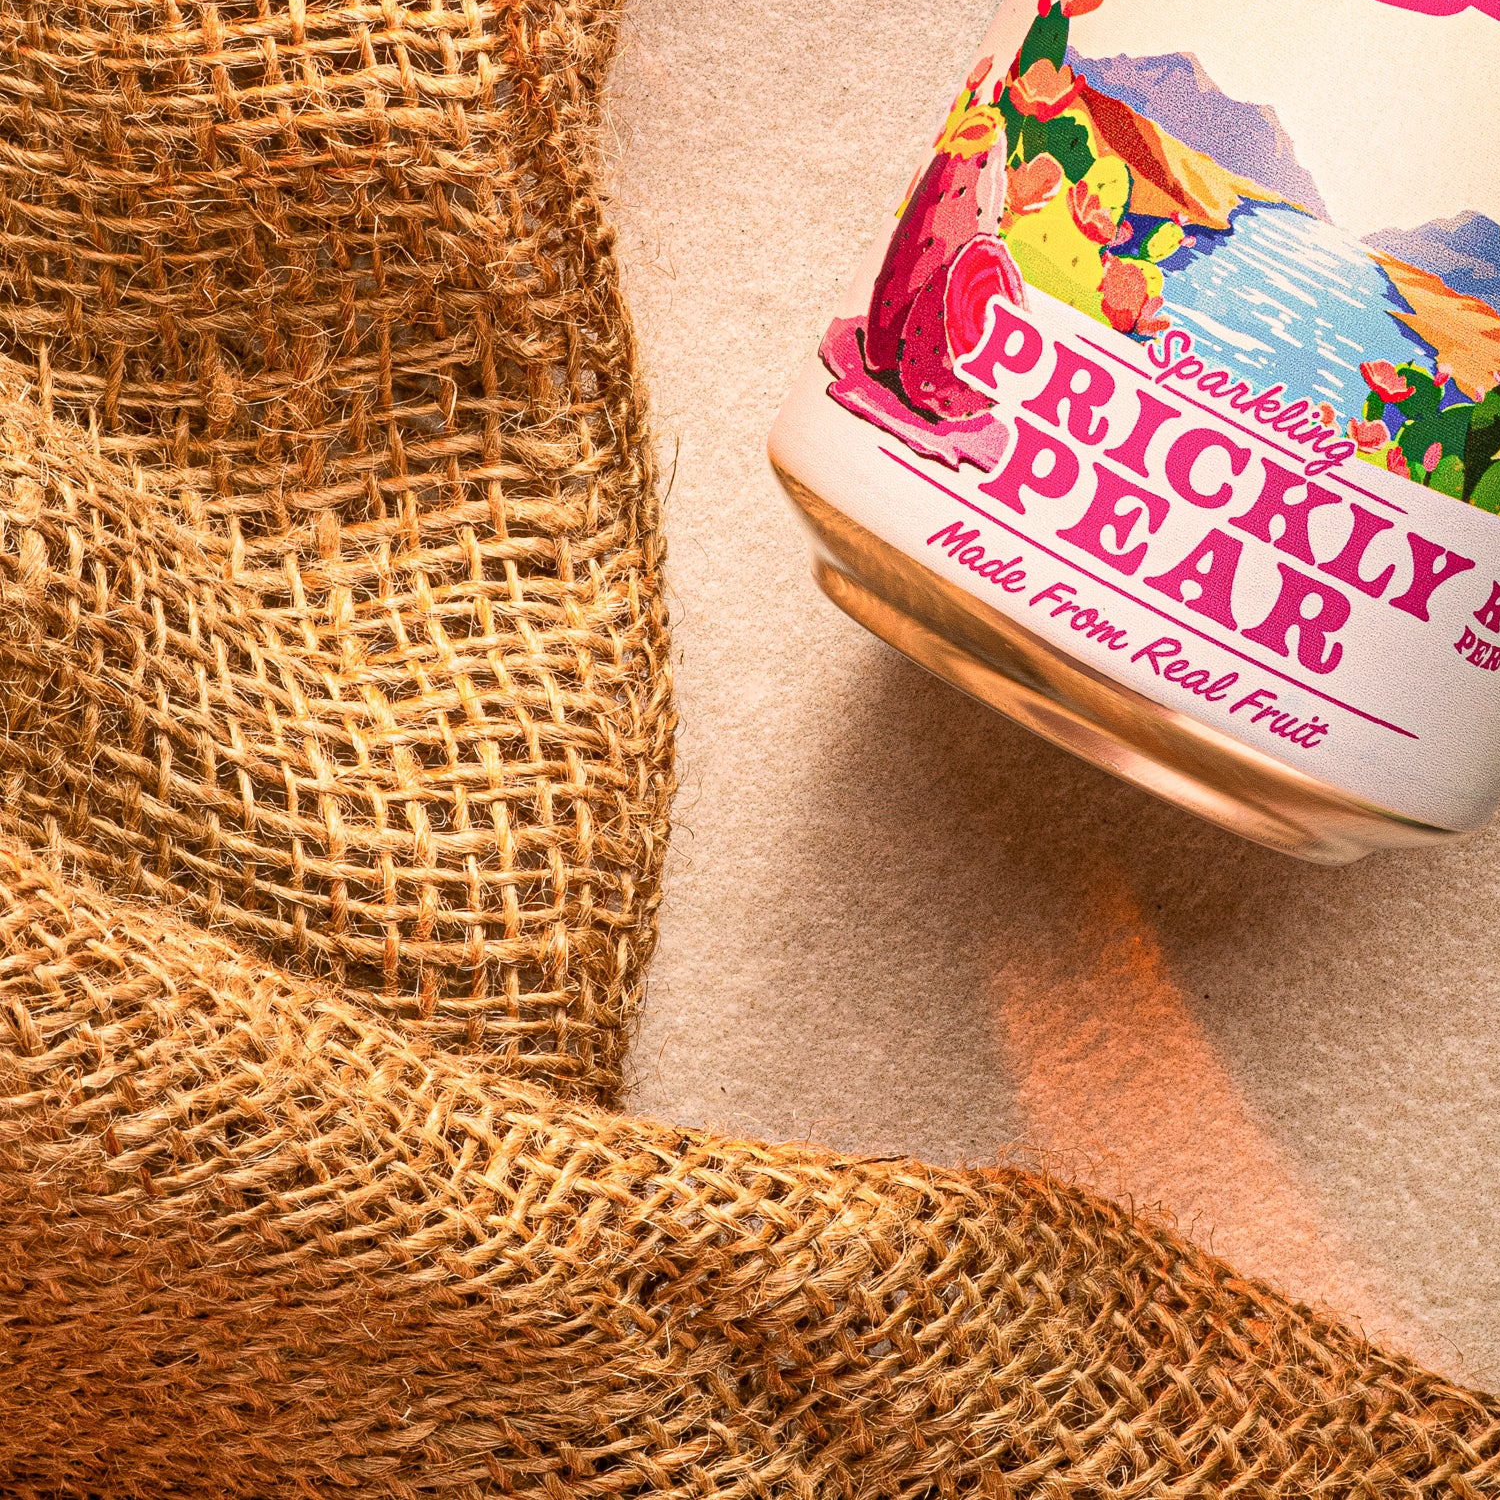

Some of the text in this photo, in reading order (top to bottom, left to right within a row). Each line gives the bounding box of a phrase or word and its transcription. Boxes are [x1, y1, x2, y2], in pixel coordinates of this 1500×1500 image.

[960, 303, 1476, 623] PRICKLY
[1147, 329, 1356, 477] Sparkling
[926, 520, 1332, 750] Made From Real Fruit
[978, 416, 1350, 675] PEAR
